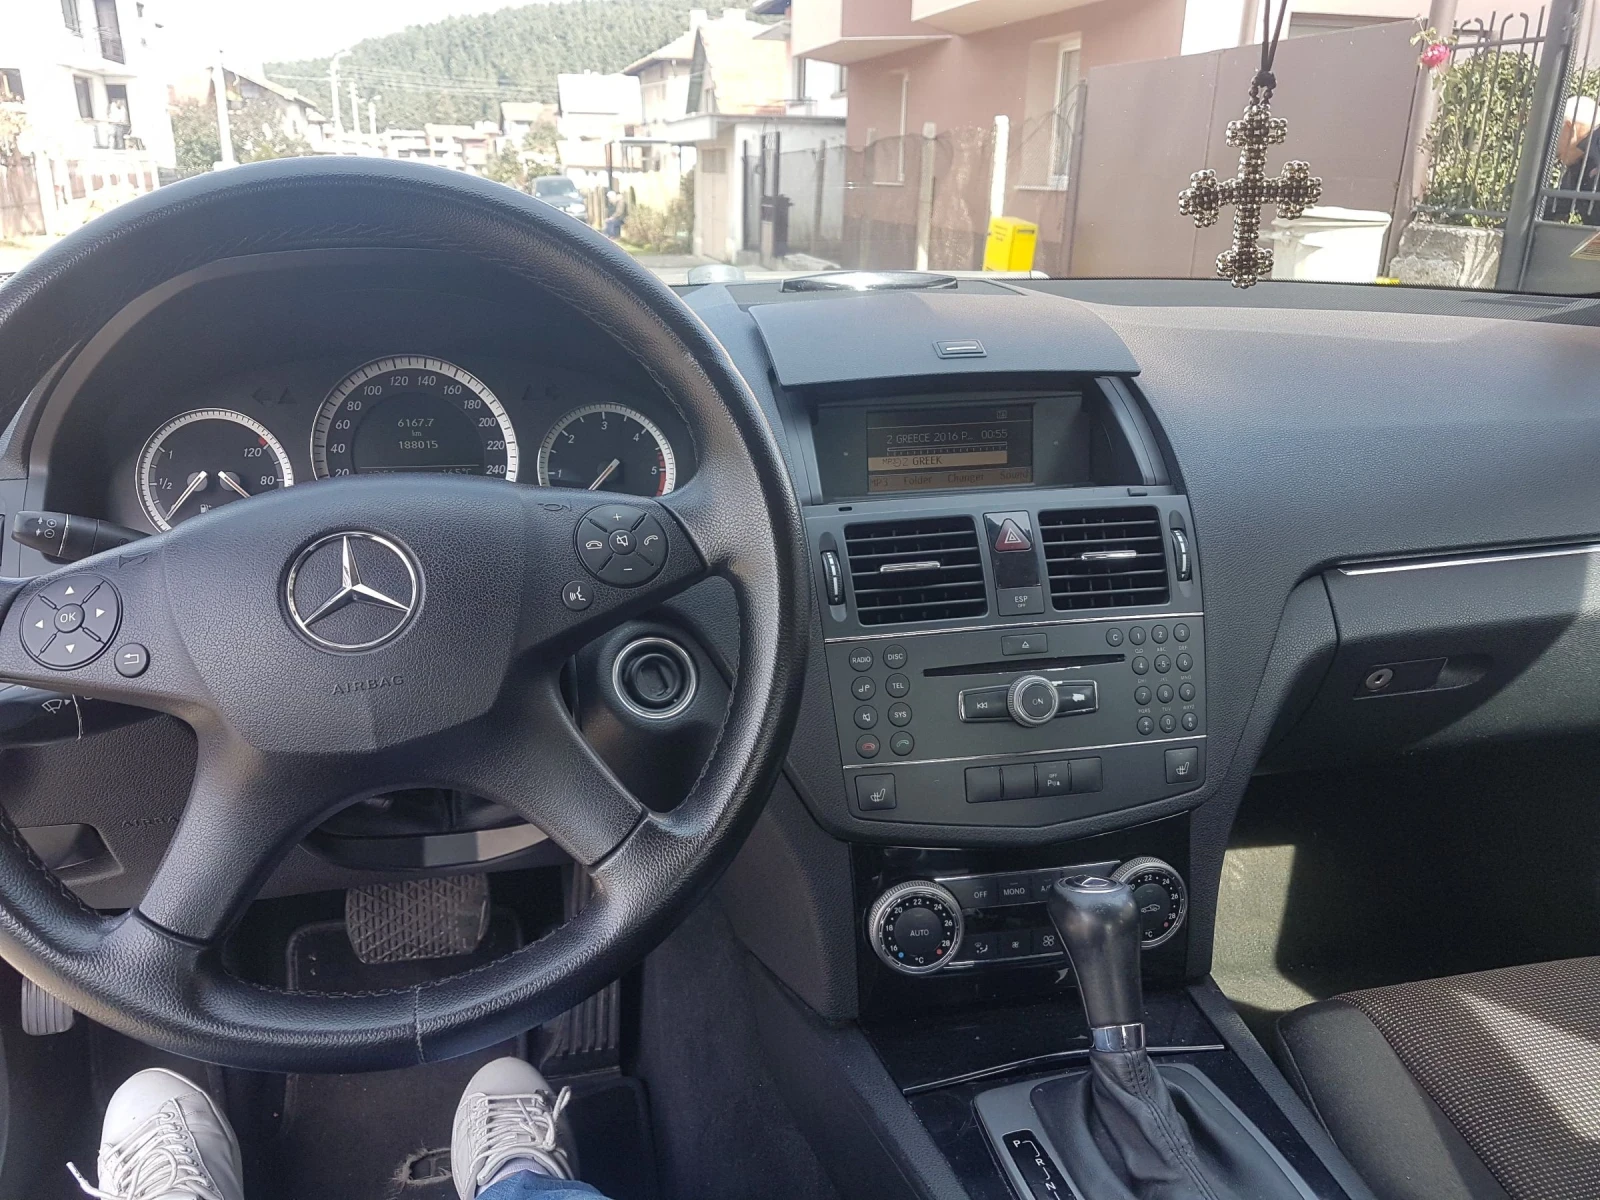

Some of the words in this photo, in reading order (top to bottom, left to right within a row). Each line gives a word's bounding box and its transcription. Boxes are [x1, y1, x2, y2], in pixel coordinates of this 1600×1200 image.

[390, 375, 409, 386] 120
[417, 375, 436, 386] 140
[363, 385, 382, 396] 100
[443, 385, 462, 395] 160
[347, 401, 362, 411] 80
[463, 399, 481, 410] 180
[335, 419, 350, 430] 60
[397, 418, 434, 428] 6167.7
[479, 417, 496, 427] 200
[601, 421, 608, 430] 3
[568, 434, 575, 444] 2
[633, 432, 640, 442] 4
[896, 433, 930, 444] GREECE
[933, 432, 959, 442] 2016
[981, 429, 1008, 439] 00:55
[330, 443, 345, 454] 40
[399, 440, 438, 450] 188015
[487, 440, 505, 450] 220
[243, 447, 262, 458] 120
[912, 455, 943, 466] GREEK
[335, 468, 349, 476] 20
[486, 465, 505, 474] 240
[651, 466, 657, 475] 5
[260, 475, 275, 485] 80
[903, 475, 932, 486] Folder
[1014, 595, 1028, 603] ESP
[60, 611, 76, 623] OK
[1112, 633, 1119, 641] C
[1158, 630, 1164, 638] 2
[1180, 629, 1186, 637] 3
[852, 656, 871, 664] RADIO
[887, 653, 904, 661] DISC
[332, 675, 404, 695] AIRBAG
[973, 890, 988, 899] OFF
[1003, 886, 1026, 896] MONO
[913, 898, 922, 906] 22
[944, 919, 953, 927] 26
[910, 929, 930, 937] AUTO
[1012, 1140, 1021, 1148] P
[1035, 1158, 1046, 1166] R
[1045, 1181, 1057, 1191] N
